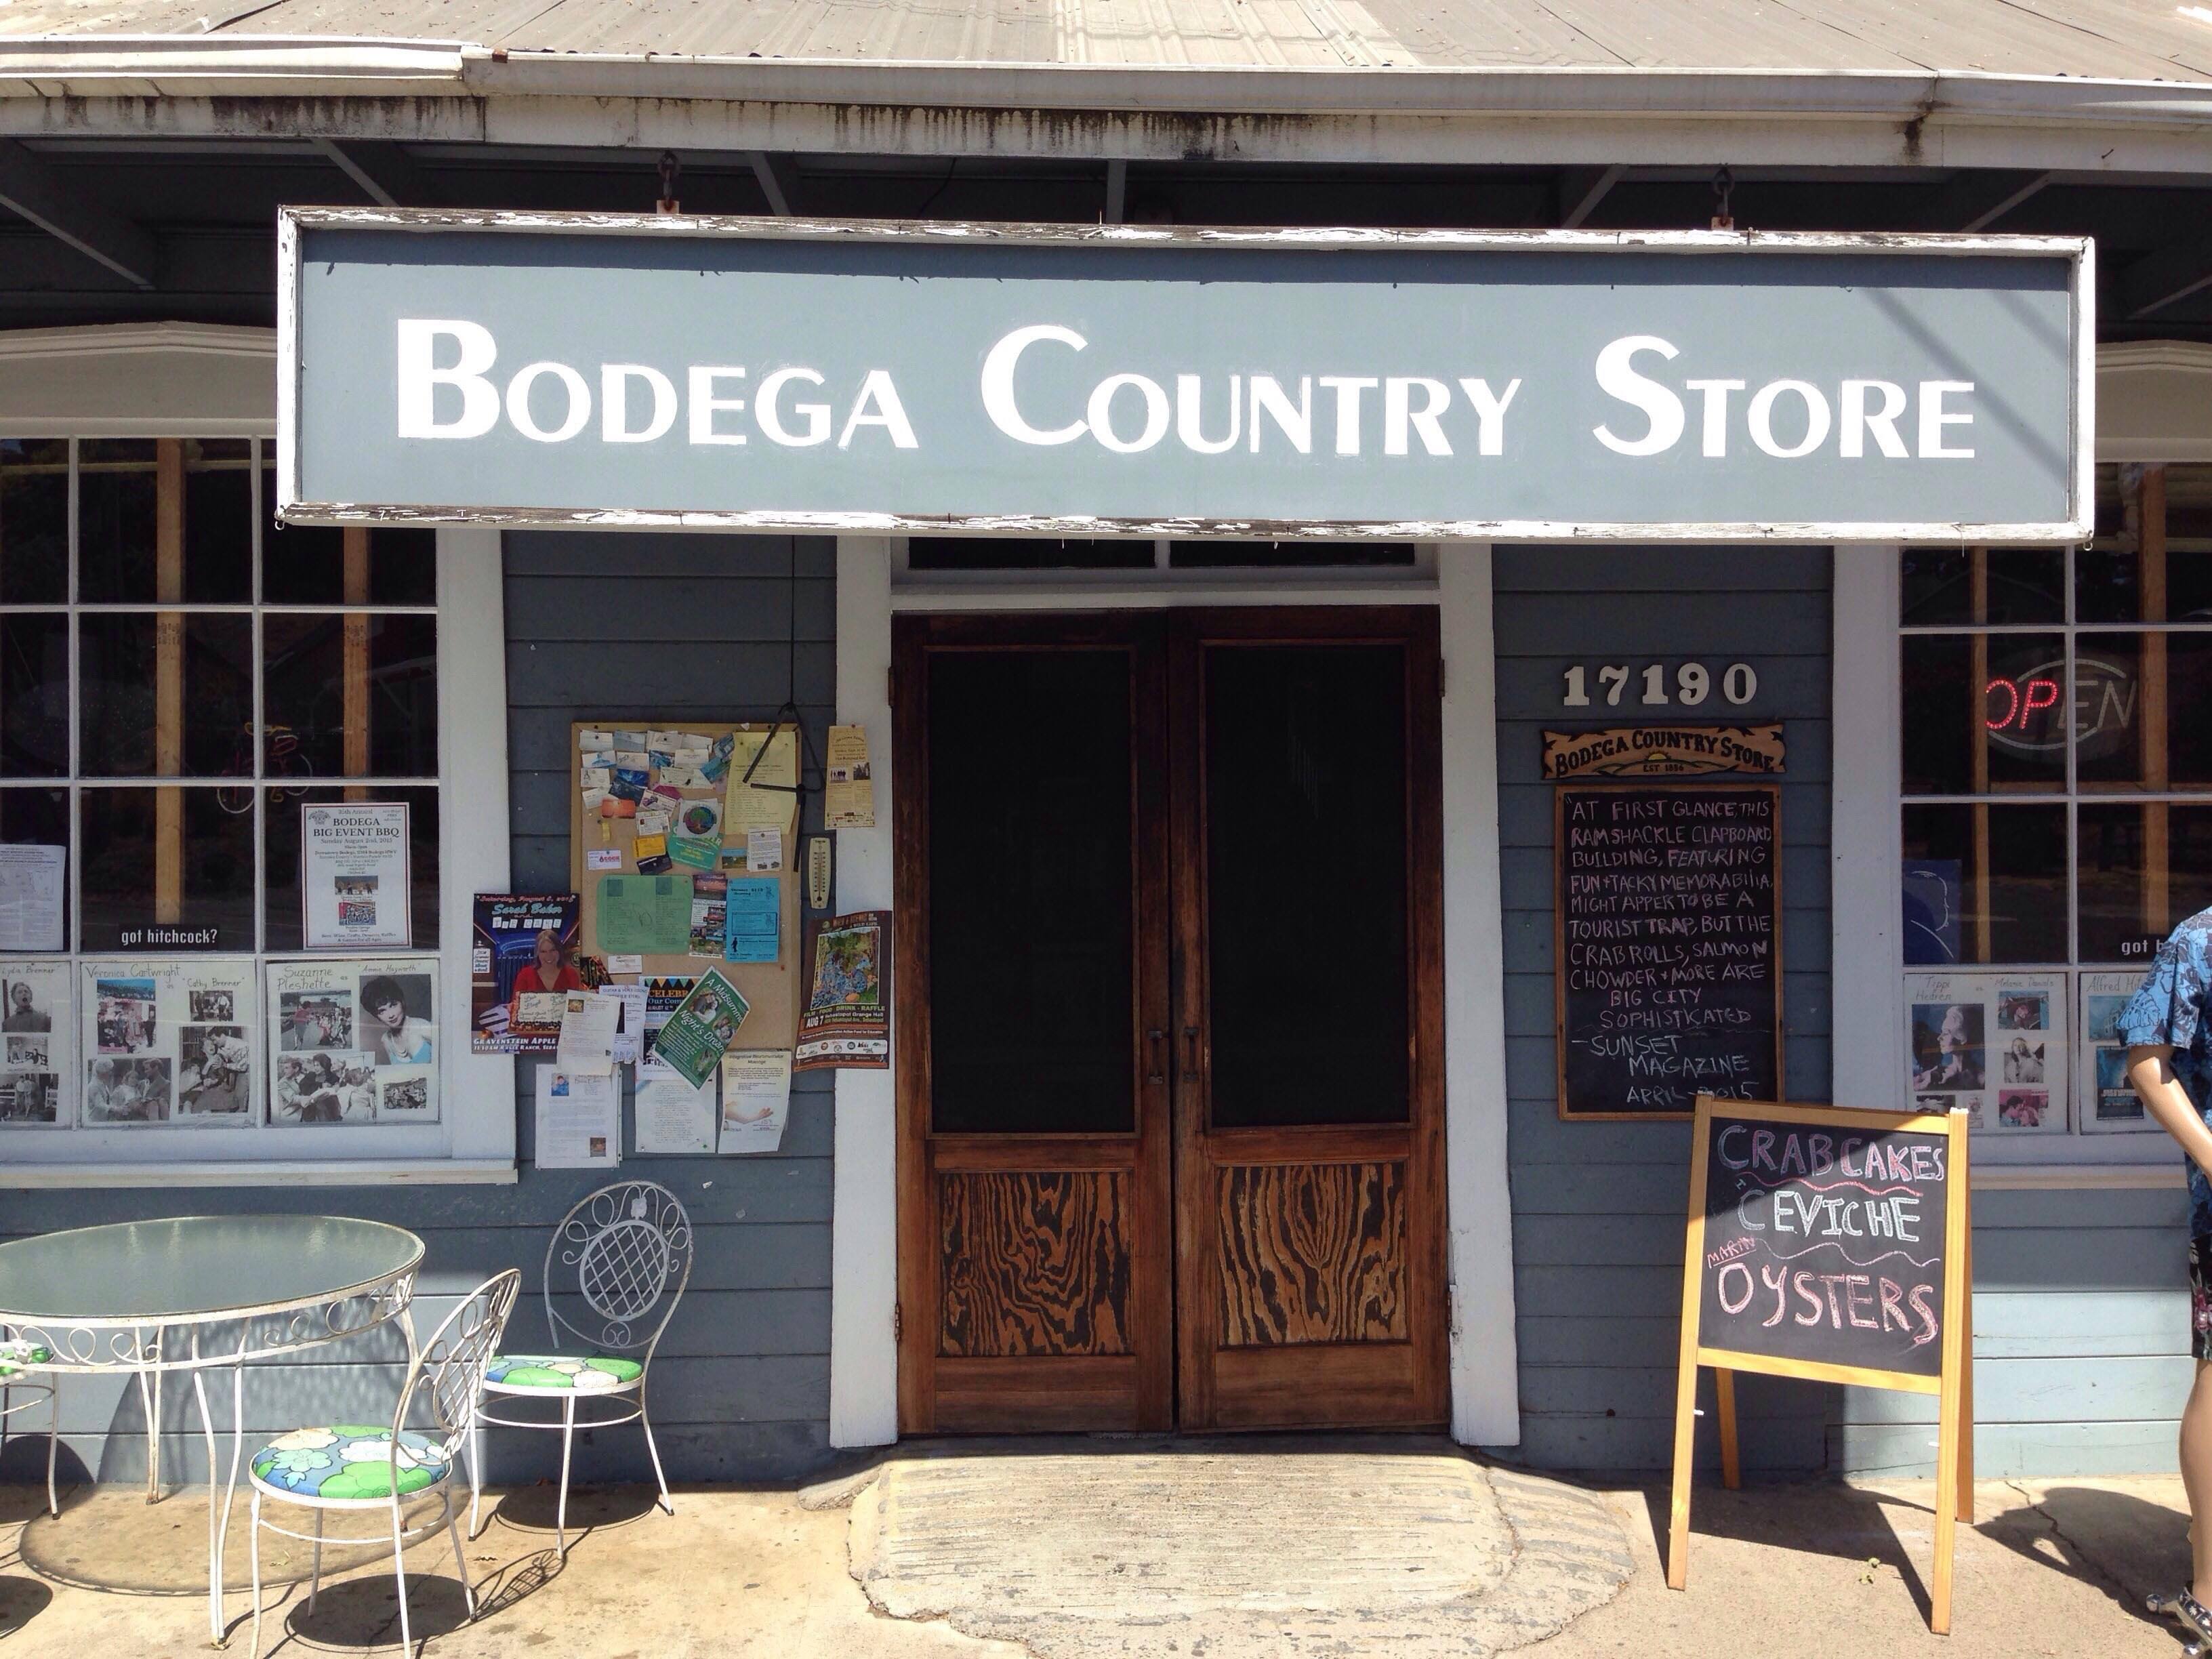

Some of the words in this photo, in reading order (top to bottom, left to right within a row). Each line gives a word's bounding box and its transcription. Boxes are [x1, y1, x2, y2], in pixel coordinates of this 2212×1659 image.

[398, 319, 919, 449] BODEGA
[981, 325, 1521, 455] COUNTRY
[1593, 335, 1975, 459] STORE
[1563, 662, 1757, 706] 17190
[1984, 678, 2137, 730] OPEN
[1555, 737, 1629, 778] BODEGA
[1632, 730, 1717, 754] COUNTRY
[1721, 737, 1775, 772] STORE
[1612, 800, 1668, 821] FIRST
[1739, 802, 1769, 816] THIS
[313, 828, 332, 837] BIG
[335, 828, 372, 837] EVENT
[376, 827, 400, 838] BBQ
[333, 818, 380, 826] BODEGA
[1668, 846, 1765, 867] FEATURING
[1571, 875, 1600, 895] FUN
[1609, 874, 1656, 893] TACKY
[1572, 896, 1617, 913] MIGHT
[1677, 895, 1698, 910] TO
[1702, 893, 1729, 909] BE
[1736, 890, 1754, 908] A
[121, 930, 142, 946] got
[147, 929, 218, 944] hitchcock?
[1569, 920, 1643, 939] TOURIST
[1701, 916, 1732, 933] BUT
[1735, 916, 1771, 933] THE
[1693, 940, 1767, 958] SALMON
[2121, 939, 2148, 956] got
[85, 965, 125, 979] Veronica
[130, 964, 181, 981] Cartwright
[284, 966, 333, 979] Suzanne
[1570, 968, 1657, 989] CHOWDER
[1671, 964, 1715, 985] MORE
[1722, 962, 1766, 981] ARE
[277, 978, 331, 991] Pleshette
[649, 989, 689, 998] CELEBR
[2087, 975, 2121, 992] Alfred
[705, 979, 715, 987] A
[714, 983, 745, 1024] Midsumme
[1611, 989, 1641, 1007] BIG
[1652, 987, 1701, 1005] CITY
[806, 1017, 819, 1028] AUG
[819, 1016, 824, 1025] 7
[1600, 1008, 1751, 1029] SOPHISTICATED
[1629, 1054, 1750, 1078] MAGAZINE
[1738, 1189, 1921, 1243] CEVICHE
[1707, 1236, 1757, 1269] MARIN
[1718, 1262, 1938, 1345] OYSTERS
